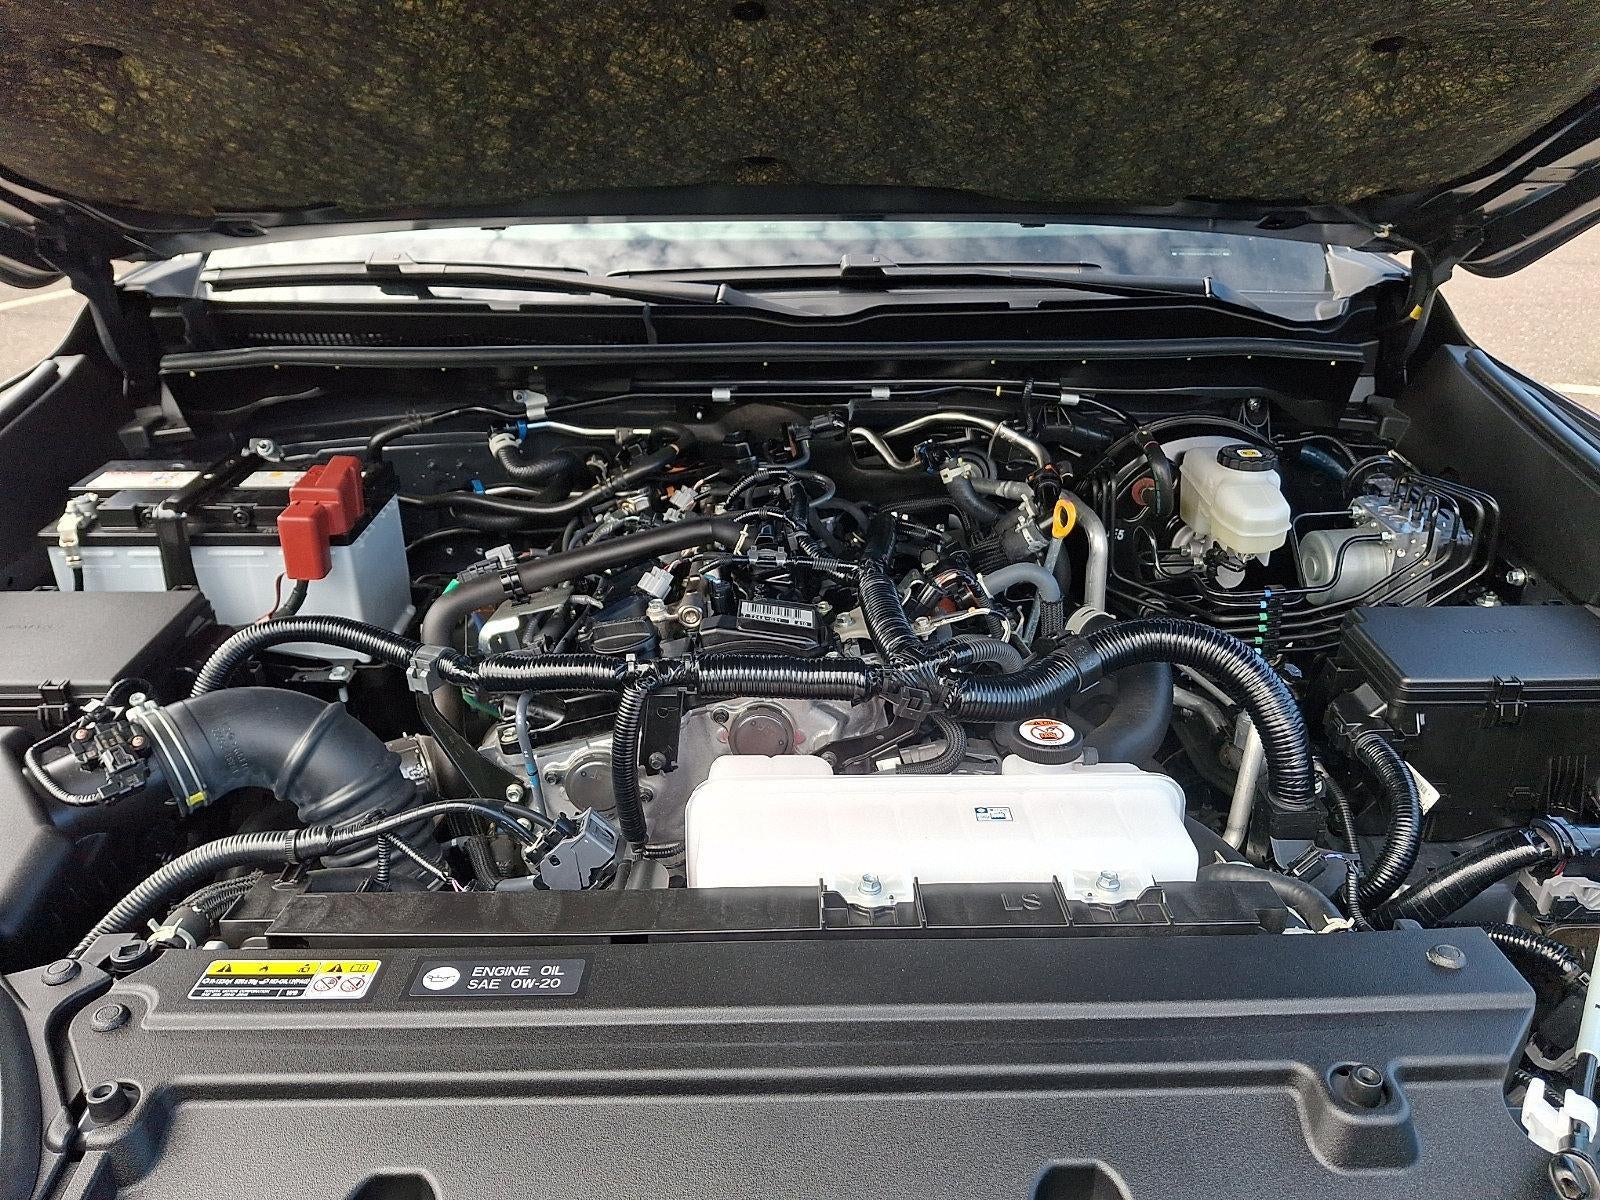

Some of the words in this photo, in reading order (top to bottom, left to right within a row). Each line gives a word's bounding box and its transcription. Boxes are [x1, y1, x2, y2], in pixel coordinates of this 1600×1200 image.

[1001, 892, 1041, 911] LS
[471, 965, 531, 977] ENGINE
[540, 965, 565, 976] OIL
[466, 978, 502, 990] SAE
[510, 978, 562, 990] 0W-20
